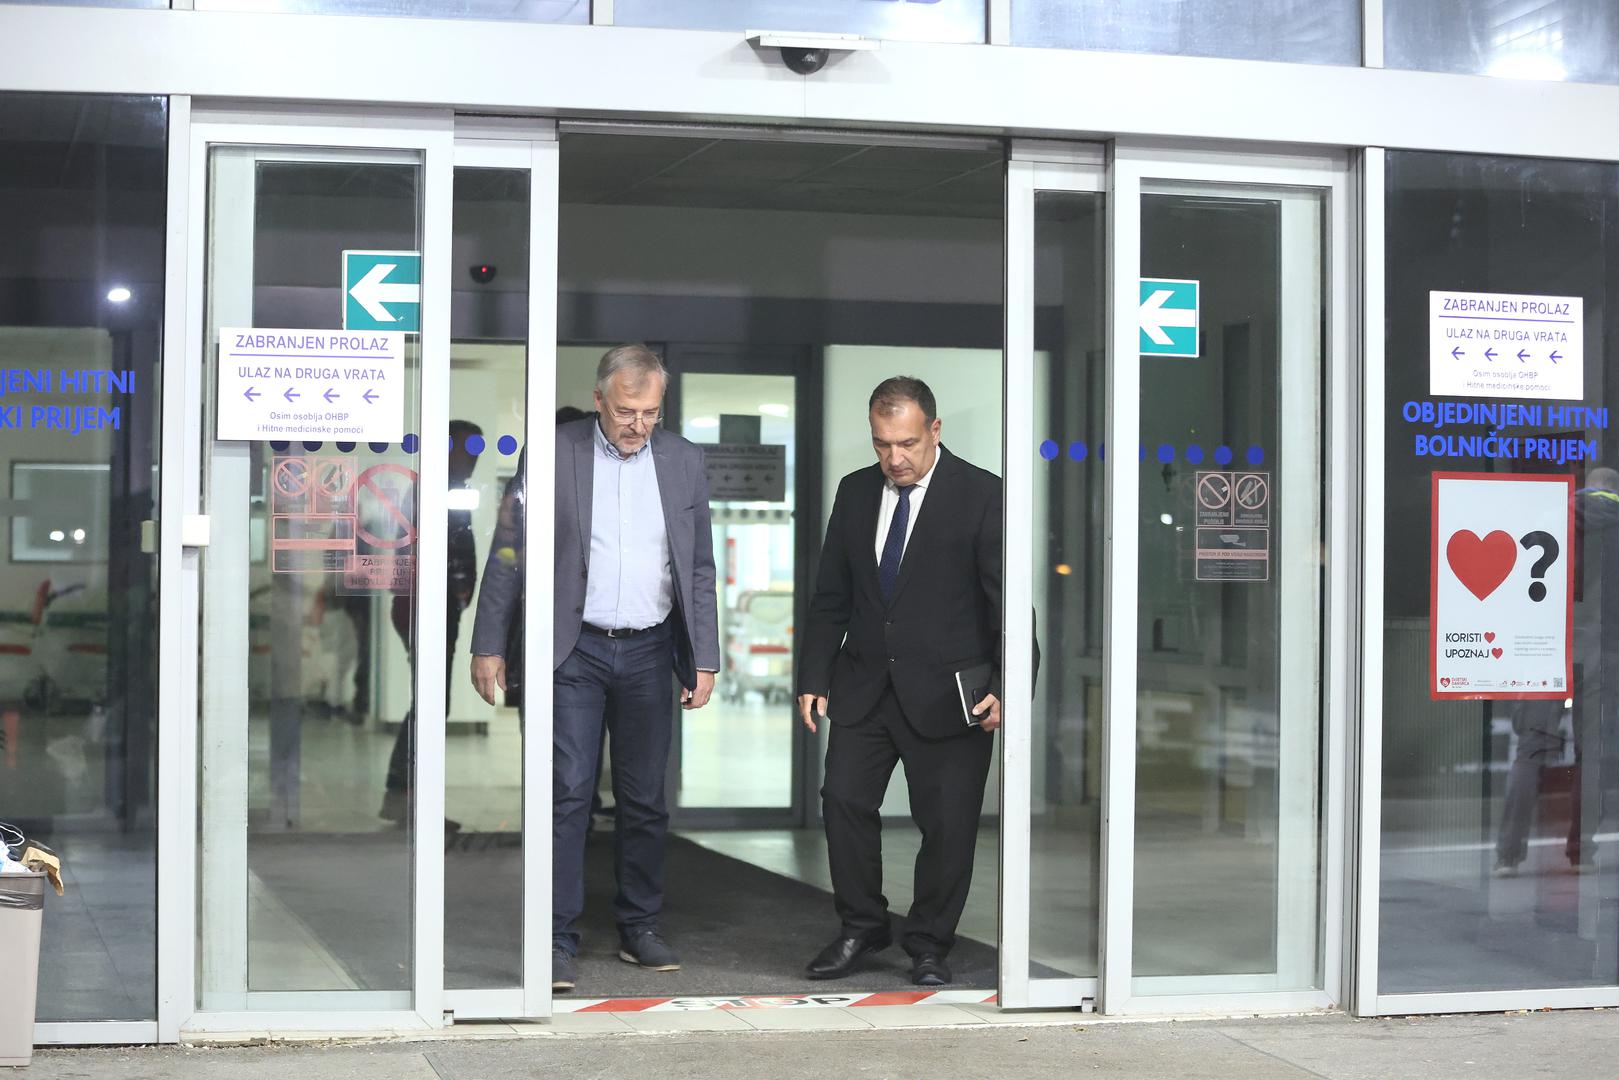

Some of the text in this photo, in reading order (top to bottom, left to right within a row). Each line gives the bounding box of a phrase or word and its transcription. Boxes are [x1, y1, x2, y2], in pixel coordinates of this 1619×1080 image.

[1443, 298, 1570, 316] ZABRANJEN PROLAZ
[236, 335, 389, 351] ZABRANJEN PROLAZ
[1446, 328, 1568, 343] ULAZ NA DRUGA VRATA
[238, 367, 386, 380] ULAZ NA DRUGA VRATA
[60, 369, 136, 394] HITNI
[31, 405, 120, 436] PRIJEM
[270, 412, 291, 420] Osim
[324, 413, 350, 421] OHBP
[1402, 401, 1608, 430] OBJEDINJENI HITNI
[285, 425, 331, 433] medicinske
[1415, 431, 1597, 465] BOLNIČKI PRIJEM
[1445, 633, 1481, 643] KORISTI
[1445, 649, 1489, 658] UPOZNAJ
